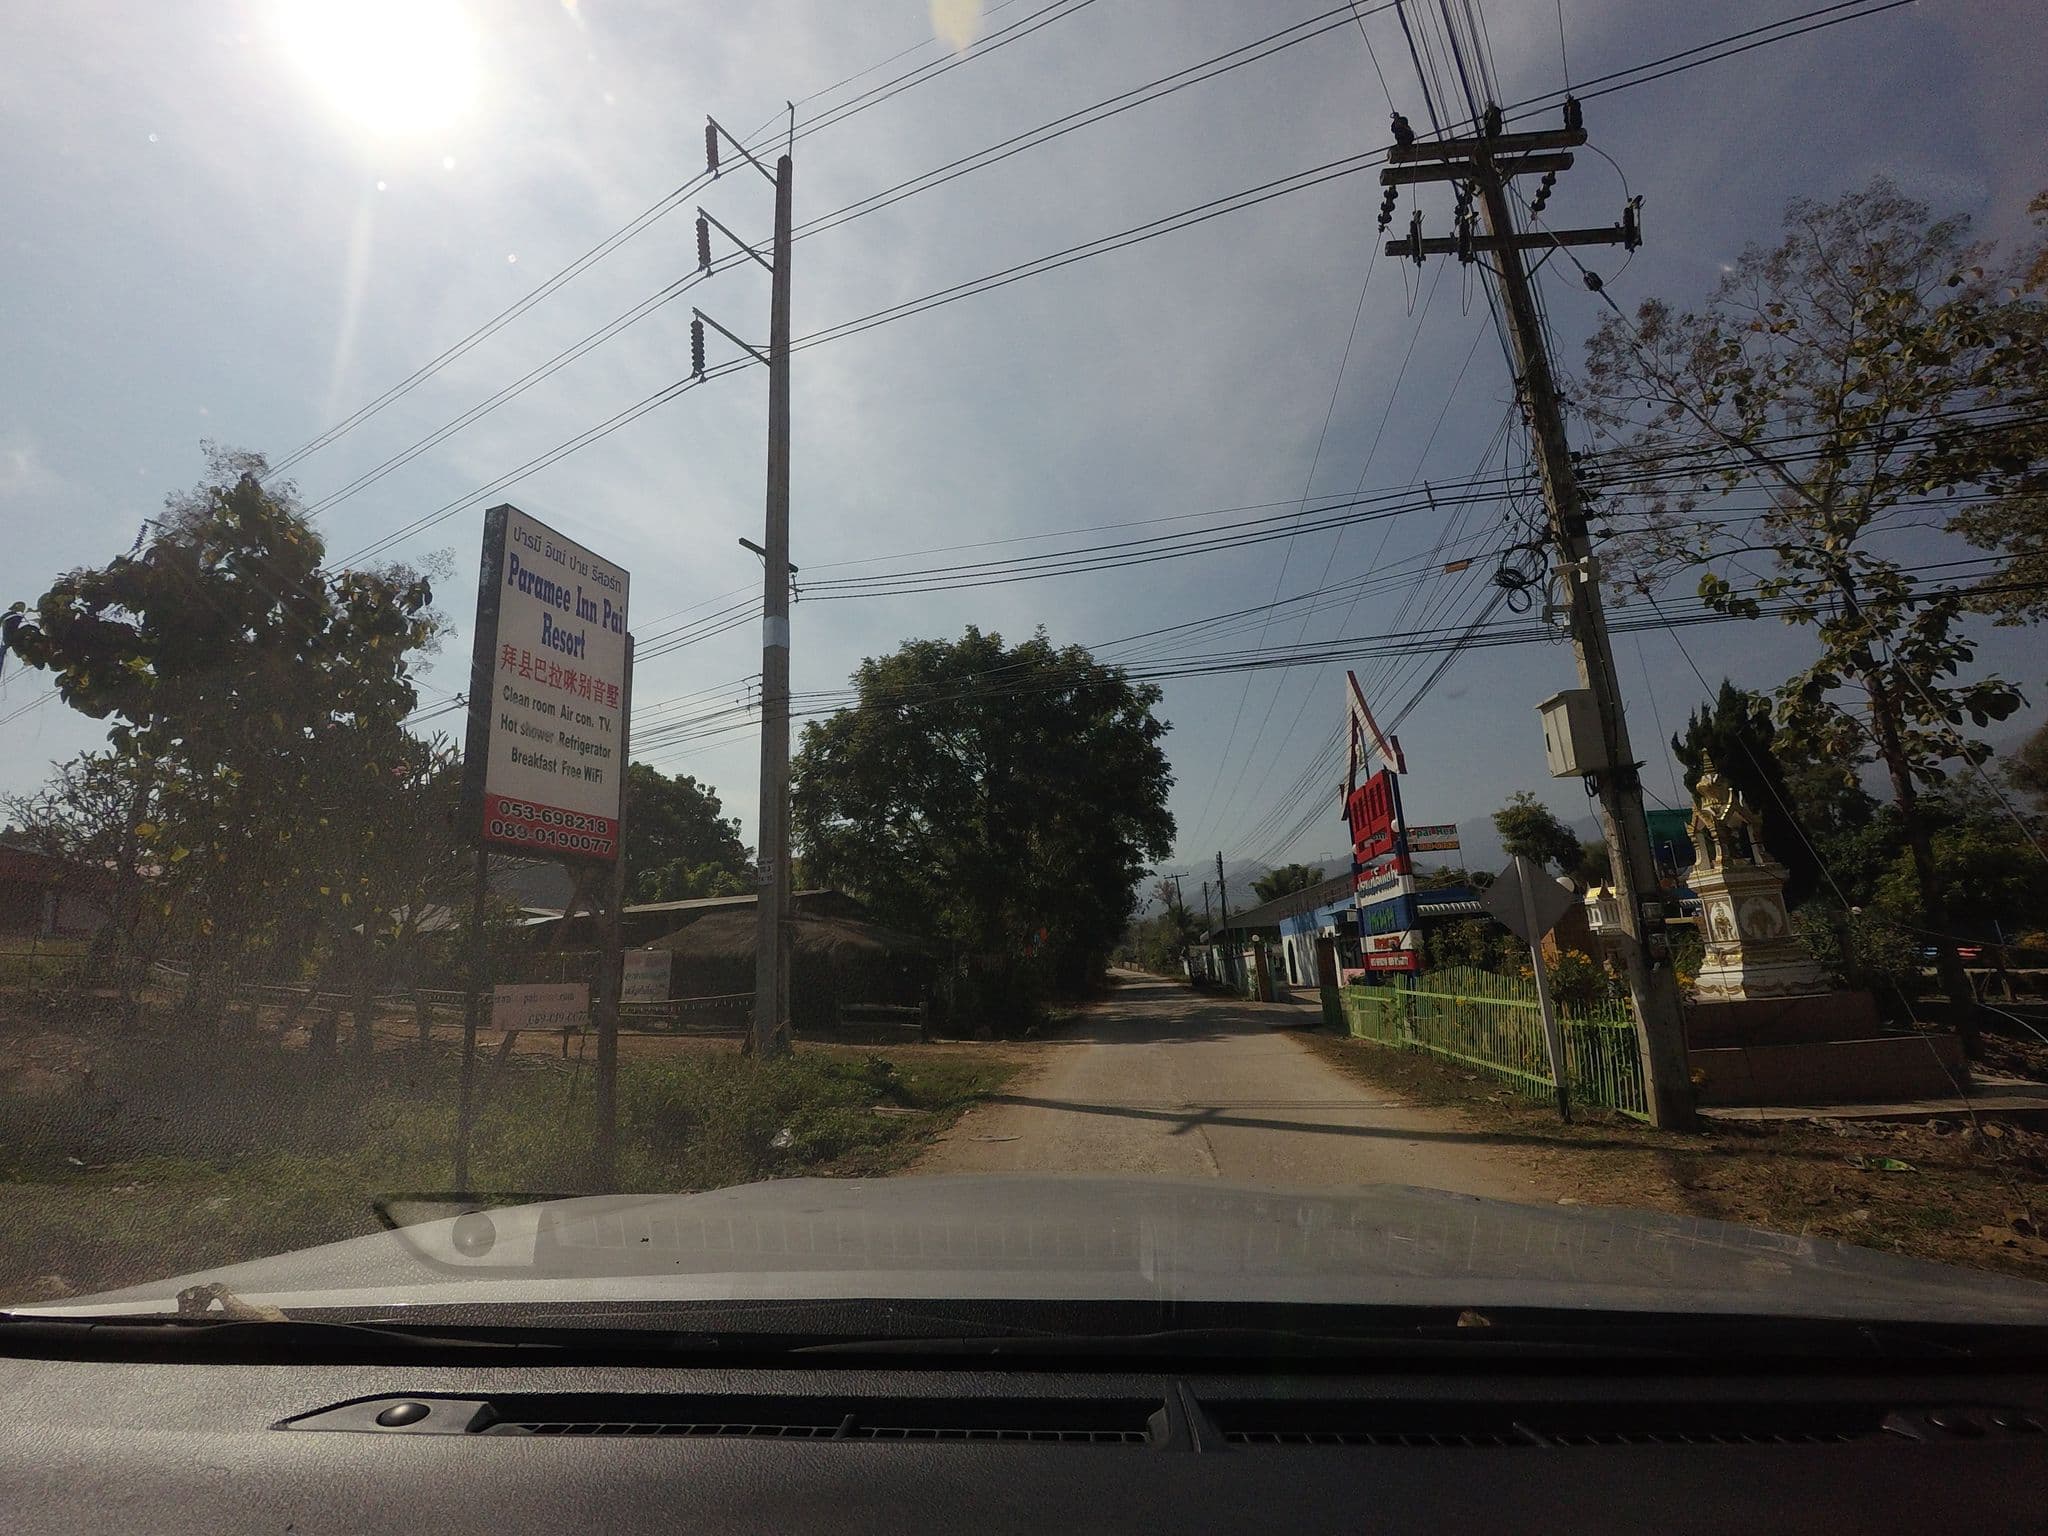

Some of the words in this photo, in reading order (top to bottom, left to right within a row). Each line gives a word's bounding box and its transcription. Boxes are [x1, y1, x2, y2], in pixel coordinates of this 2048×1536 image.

[513, 526, 543, 553] ปารมี
[569, 555, 589, 577] ปาย
[508, 552, 571, 612] Paramee
[575, 585, 598, 625] Inn
[602, 597, 624, 636] Pai
[541, 611, 586, 661] Resort
[502, 685, 530, 707] Clean
[531, 697, 556, 717] room
[560, 704, 574, 722] Air
[575, 711, 595, 728] con.
[598, 715, 613, 734] TV.
[500, 713, 518, 735] Hot
[520, 722, 555, 744] shower
[558, 731, 612, 760] Refrigerator
[511, 746, 558, 774] Breakfast
[561, 759, 582, 779] Free
[583, 764, 604, 784] WiFi
[490, 819, 613, 854] 089-0190077
[498, 798, 608, 835] 053-698218
